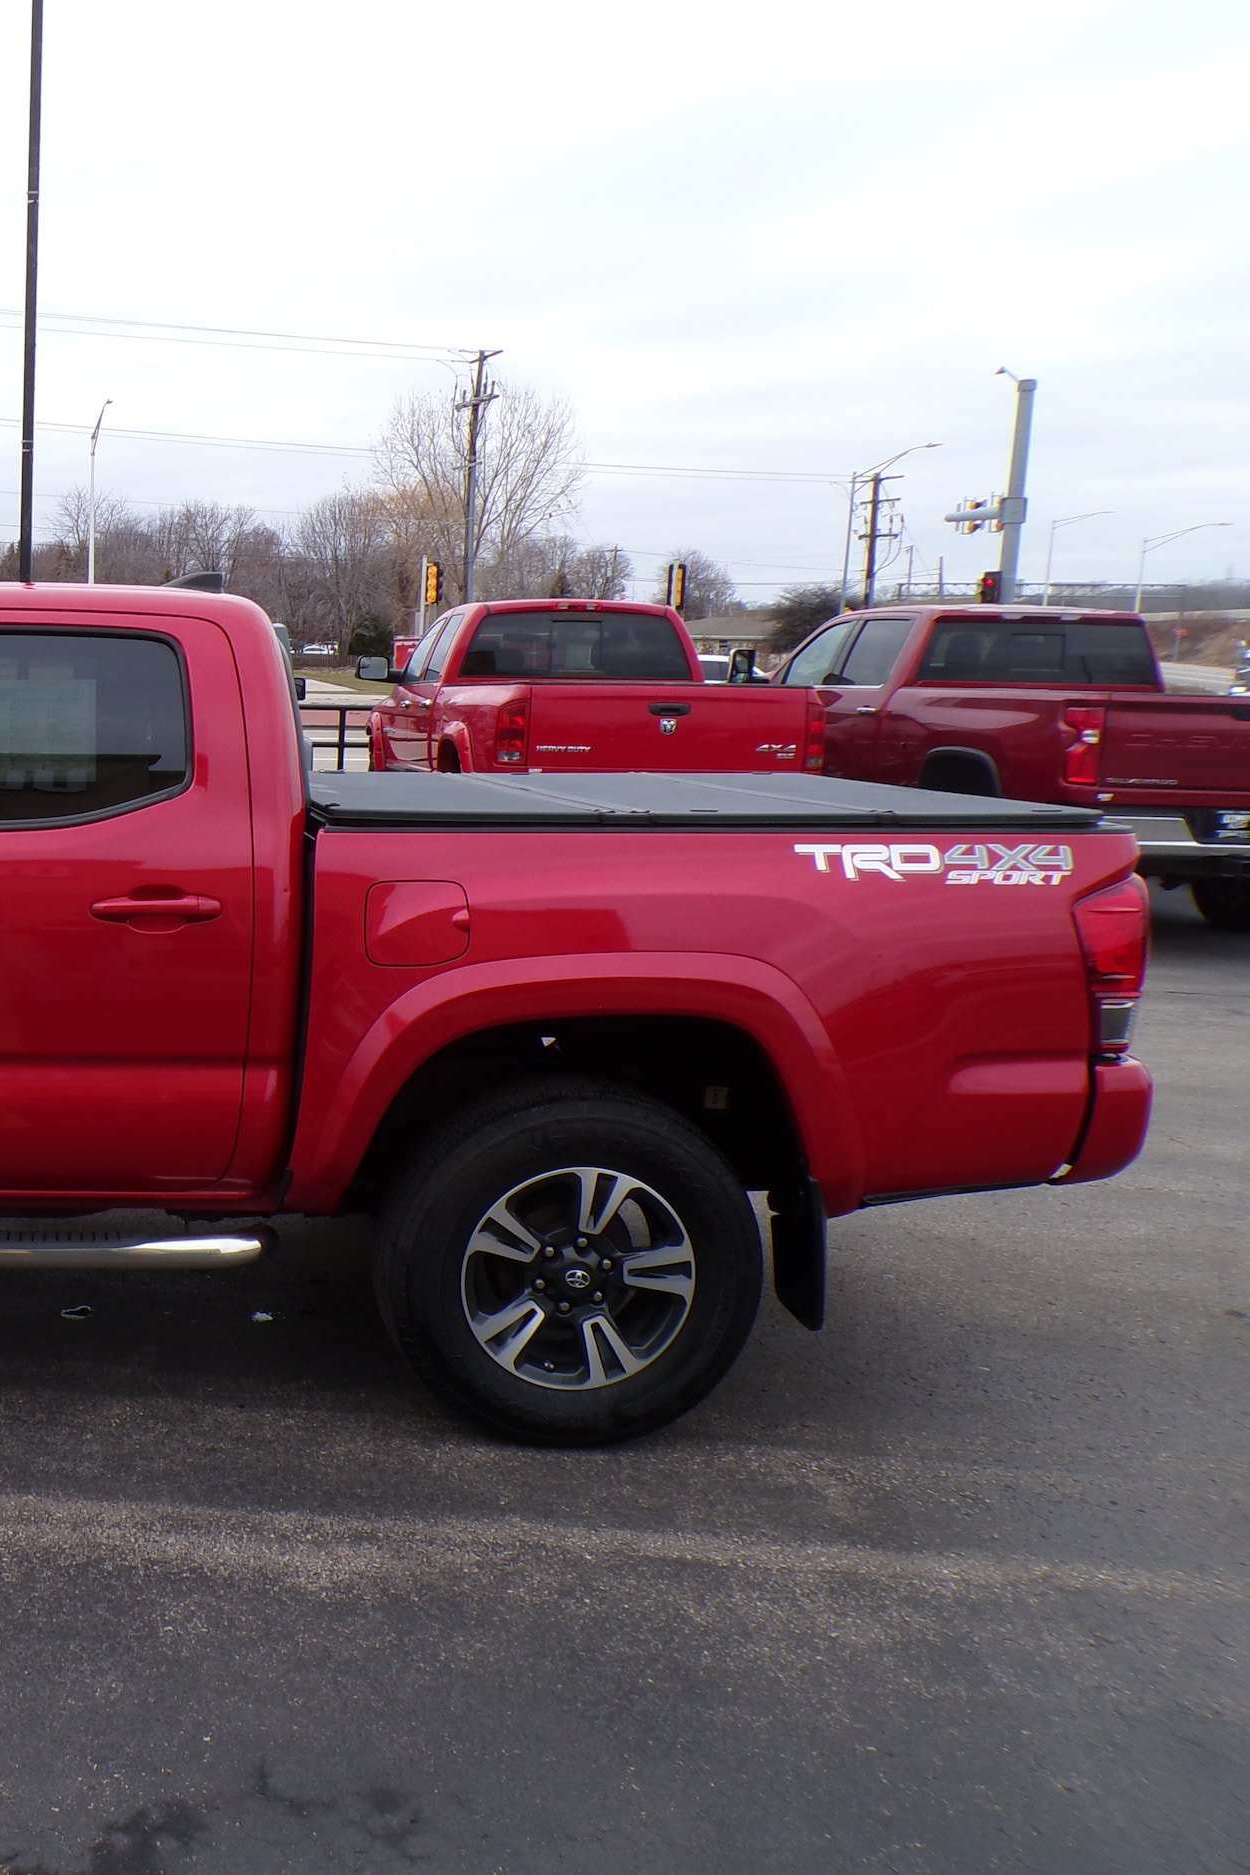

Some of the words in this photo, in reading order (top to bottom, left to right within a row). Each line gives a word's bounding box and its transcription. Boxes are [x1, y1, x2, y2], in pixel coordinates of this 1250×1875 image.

[535, 745, 566, 753] HEAVY
[567, 745, 592, 753] DUTY
[794, 844, 945, 881] TRD
[943, 844, 1075, 870] 4X4
[945, 869, 1072, 886] SPORT
